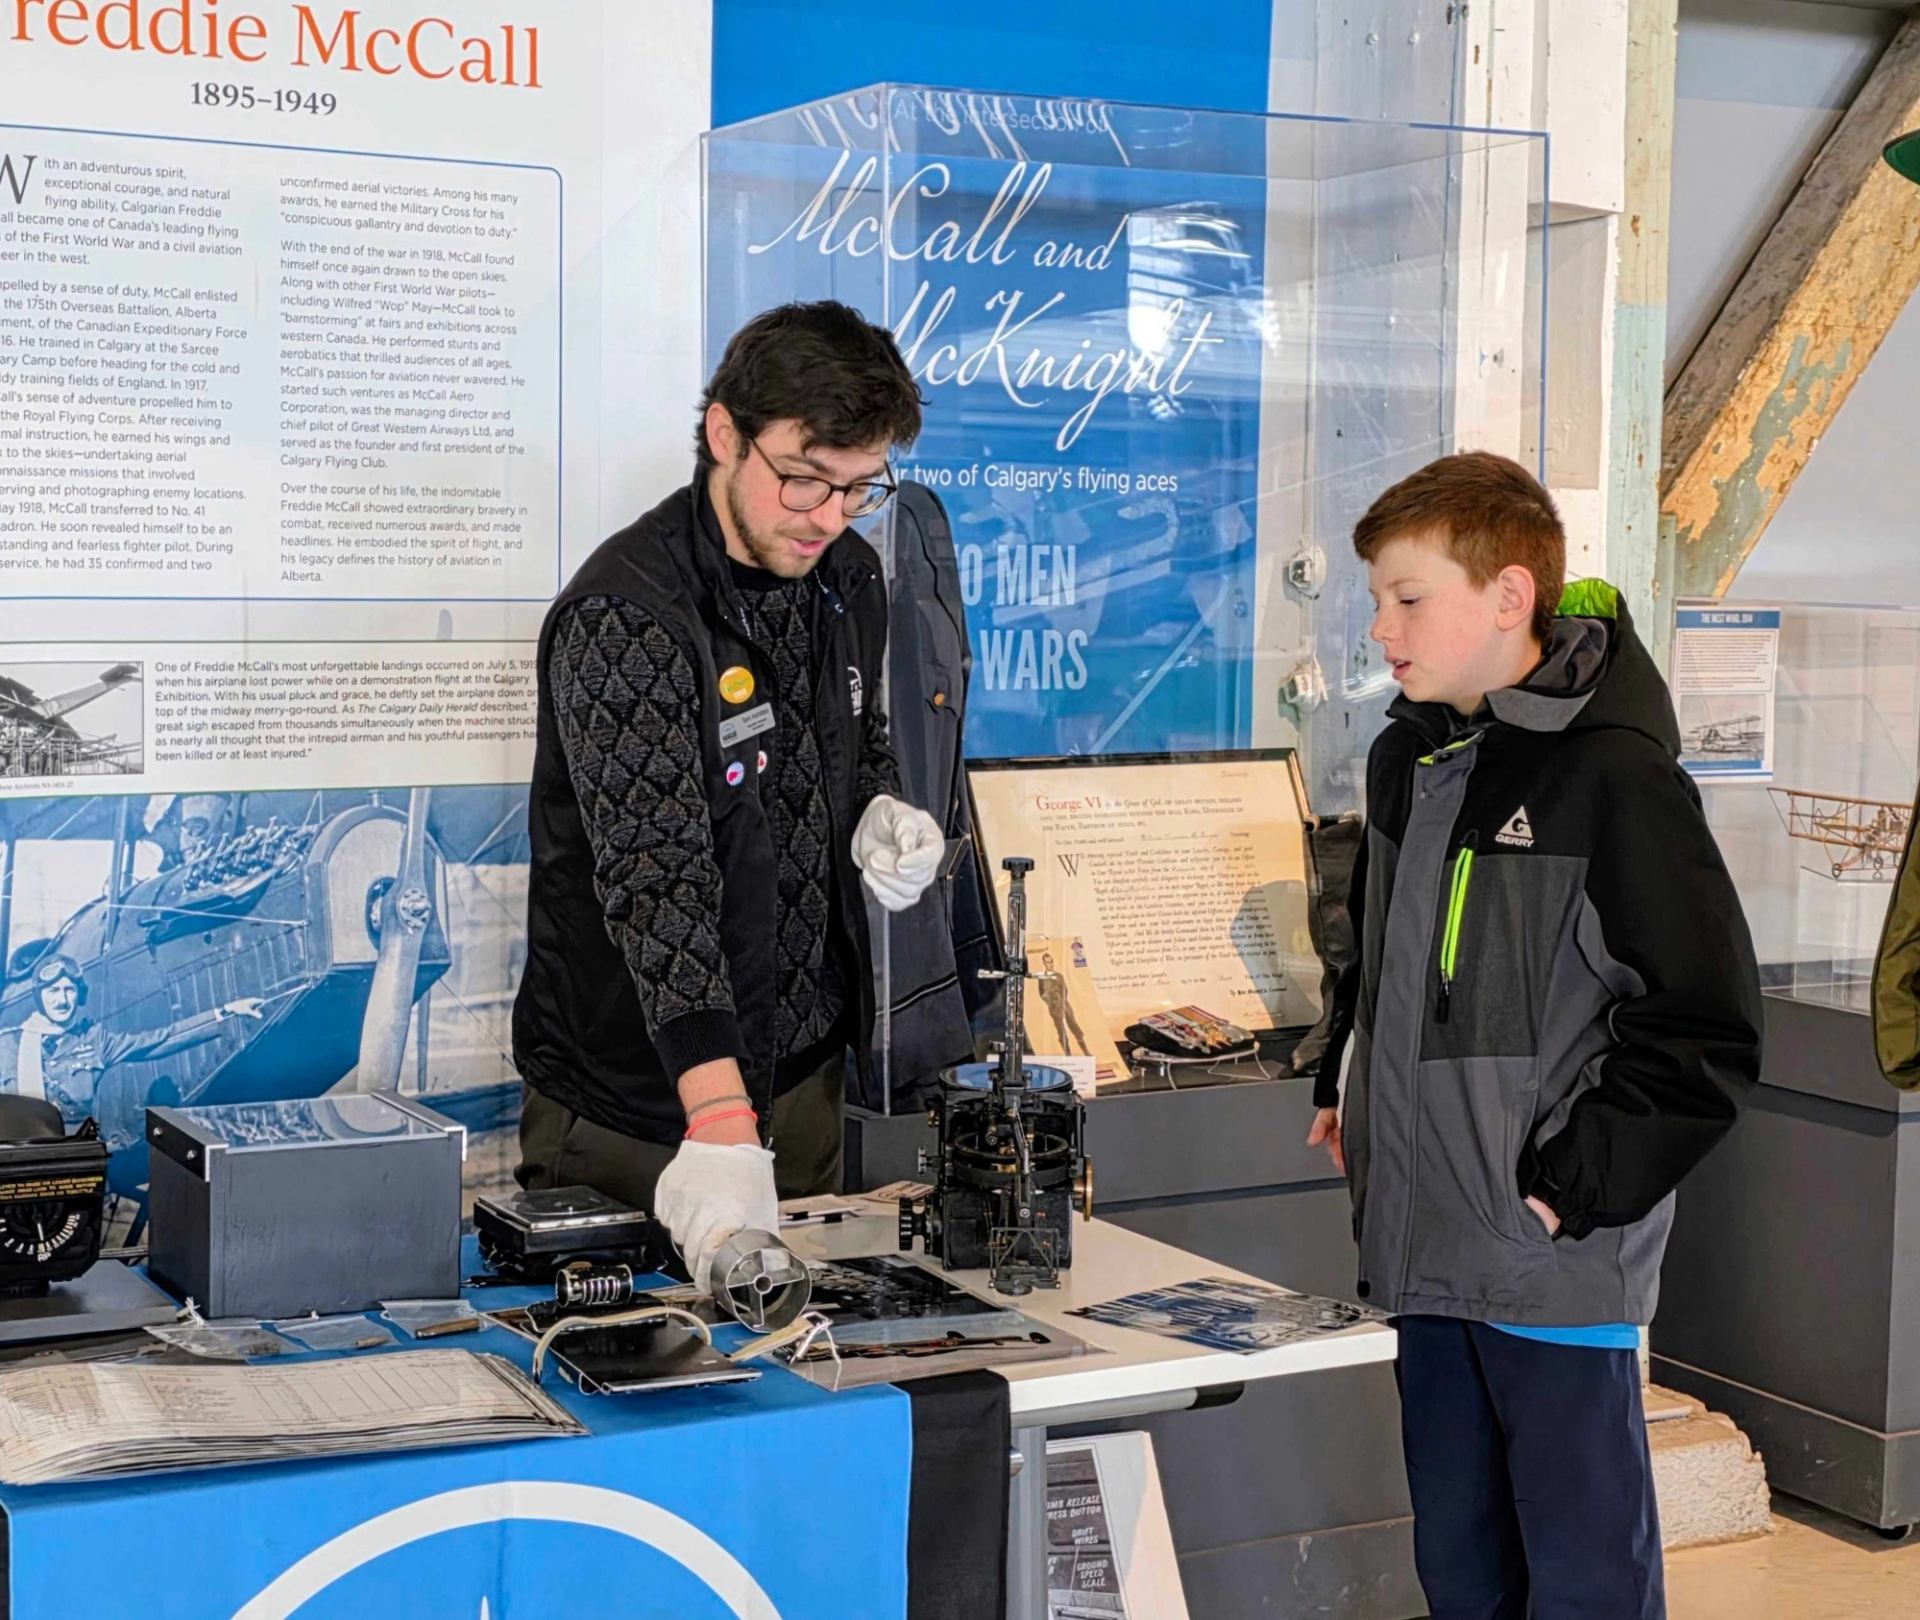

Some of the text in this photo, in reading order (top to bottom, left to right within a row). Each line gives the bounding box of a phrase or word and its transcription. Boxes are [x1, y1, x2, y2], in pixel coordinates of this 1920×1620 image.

[10, 0, 543, 88] reddie McCall
[44, 158, 60, 169] ith
[63, 161, 77, 171] an
[79, 160, 152, 176] adventurous
[155, 167, 187, 181] spirit,
[44, 178, 230, 200] exceptional courage, and natural
[280, 177, 519, 206] unconfirmed aerial victories. Among his many
[44, 195, 222, 218] flying ability, Calgarian Freddie
[748, 149, 1129, 270] McCall and
[17, 212, 64, 226] became
[67, 217, 90, 228] one
[92, 217, 105, 229] of
[162, 221, 204, 237] leading
[207, 224, 239, 239] flying
[354, 217, 402, 233] gallantry
[404, 221, 424, 232] and
[426, 222, 472, 235] devotion
[474, 225, 486, 237] to
[281, 240, 514, 266] With the end of the war in 1918, McCall found
[3, 297, 217, 320] the 175th Overseas Battalion, Alberta
[280, 294, 330, 310] including
[332, 297, 372, 310] Wilfred
[478, 305, 501, 317] took
[504, 307, 515, 318] to
[38, 317, 247, 339] of the Canadian Expeditionary Force
[280, 401, 511, 421] Corporation, was the managing director and
[914, 464, 952, 486] two
[958, 464, 978, 486] of
[984, 465, 1072, 492] Calgary's
[1078, 465, 1129, 493] flying
[1136, 473, 1177, 491] aces
[280, 500, 528, 518] Freddie McCall showed extraordinary bravery in
[280, 518, 522, 533] combat, received numerous awards, and made
[51, 538, 233, 555] and fearless fighter pilot. During
[280, 570, 323, 582] Alberta.
[996, 544, 1077, 606] MEN
[155, 662, 178, 673] One
[180, 661, 192, 672] of
[194, 661, 235, 672] Freddie
[282, 662, 308, 672] most
[310, 660, 379, 673] unforgettable
[381, 660, 424, 673] landings
[425, 660, 469, 671] occurred
[471, 662, 484, 670] on
[486, 660, 507, 672] July
[509, 659, 518, 671] 5,
[979, 629, 1088, 691] WARS
[155, 674, 530, 688] when his airplane lost power while on a demonstration flight at the Calgary
[155, 751, 182, 761] been
[185, 750, 213, 760] killed
[216, 752, 227, 760] or
[229, 750, 240, 760] at
[243, 749, 268, 759] least
[1036, 795, 1081, 812] George
[1084, 796, 1102, 810] VI
[1495, 834, 1534, 847] GERRY
[1067, 1495, 1100, 1507] RELEASE
[1047, 1506, 1101, 1520] RESS BUTTON
[1072, 1527, 1094, 1538] DRIFT
[1075, 1535, 1098, 1545] WIRES
[1077, 1559, 1108, 1571] GROUND
[1080, 1569, 1104, 1578] SPEED
[1082, 1578, 1106, 1588] SCALE
